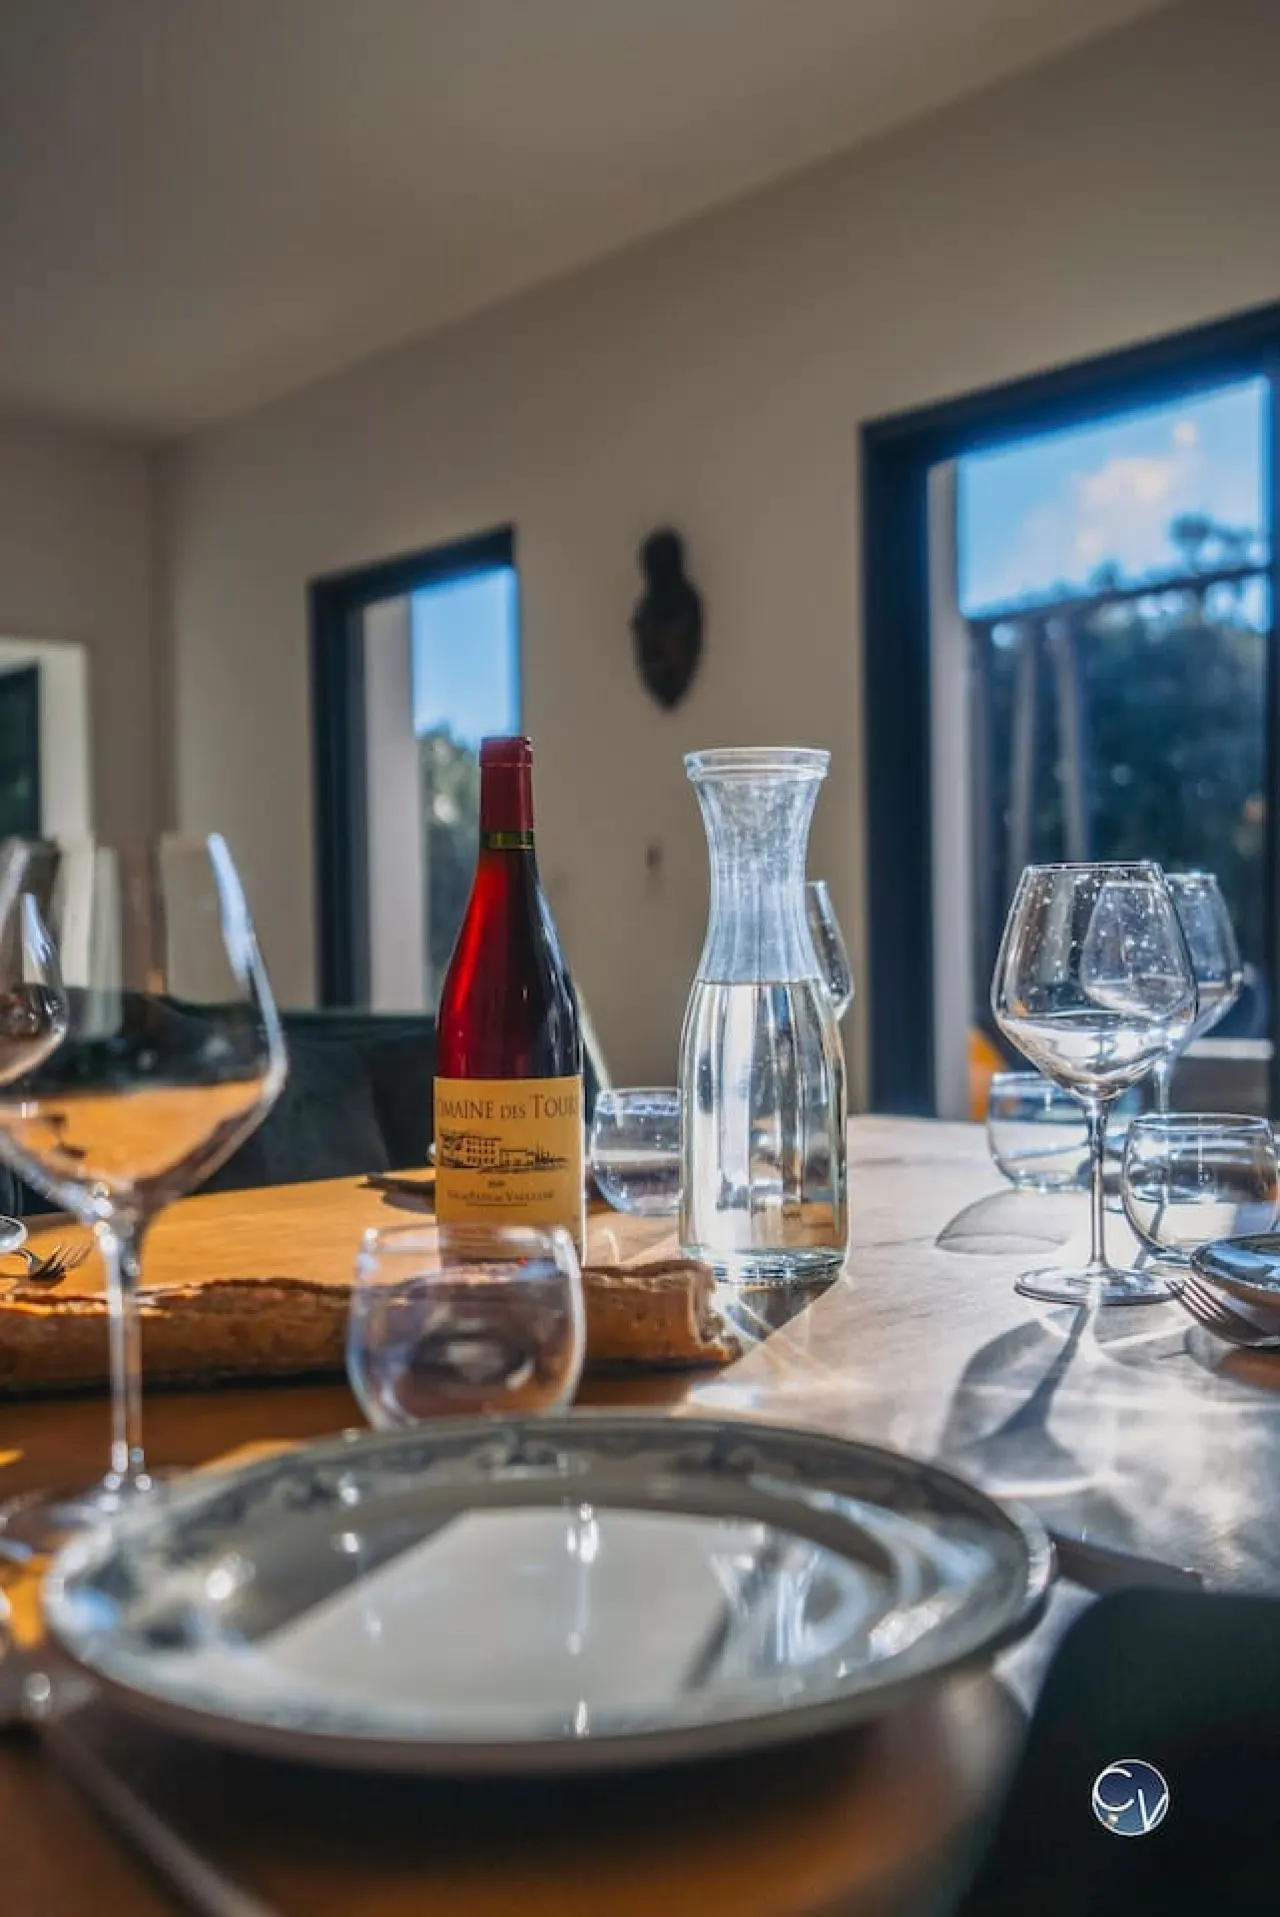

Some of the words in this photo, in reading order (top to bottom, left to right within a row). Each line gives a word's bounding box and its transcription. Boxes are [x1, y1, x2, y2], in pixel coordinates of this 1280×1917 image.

[438, 1097, 496, 1119] MAINE
[500, 1104, 526, 1119] DES
[529, 1094, 578, 1119] TOUR
